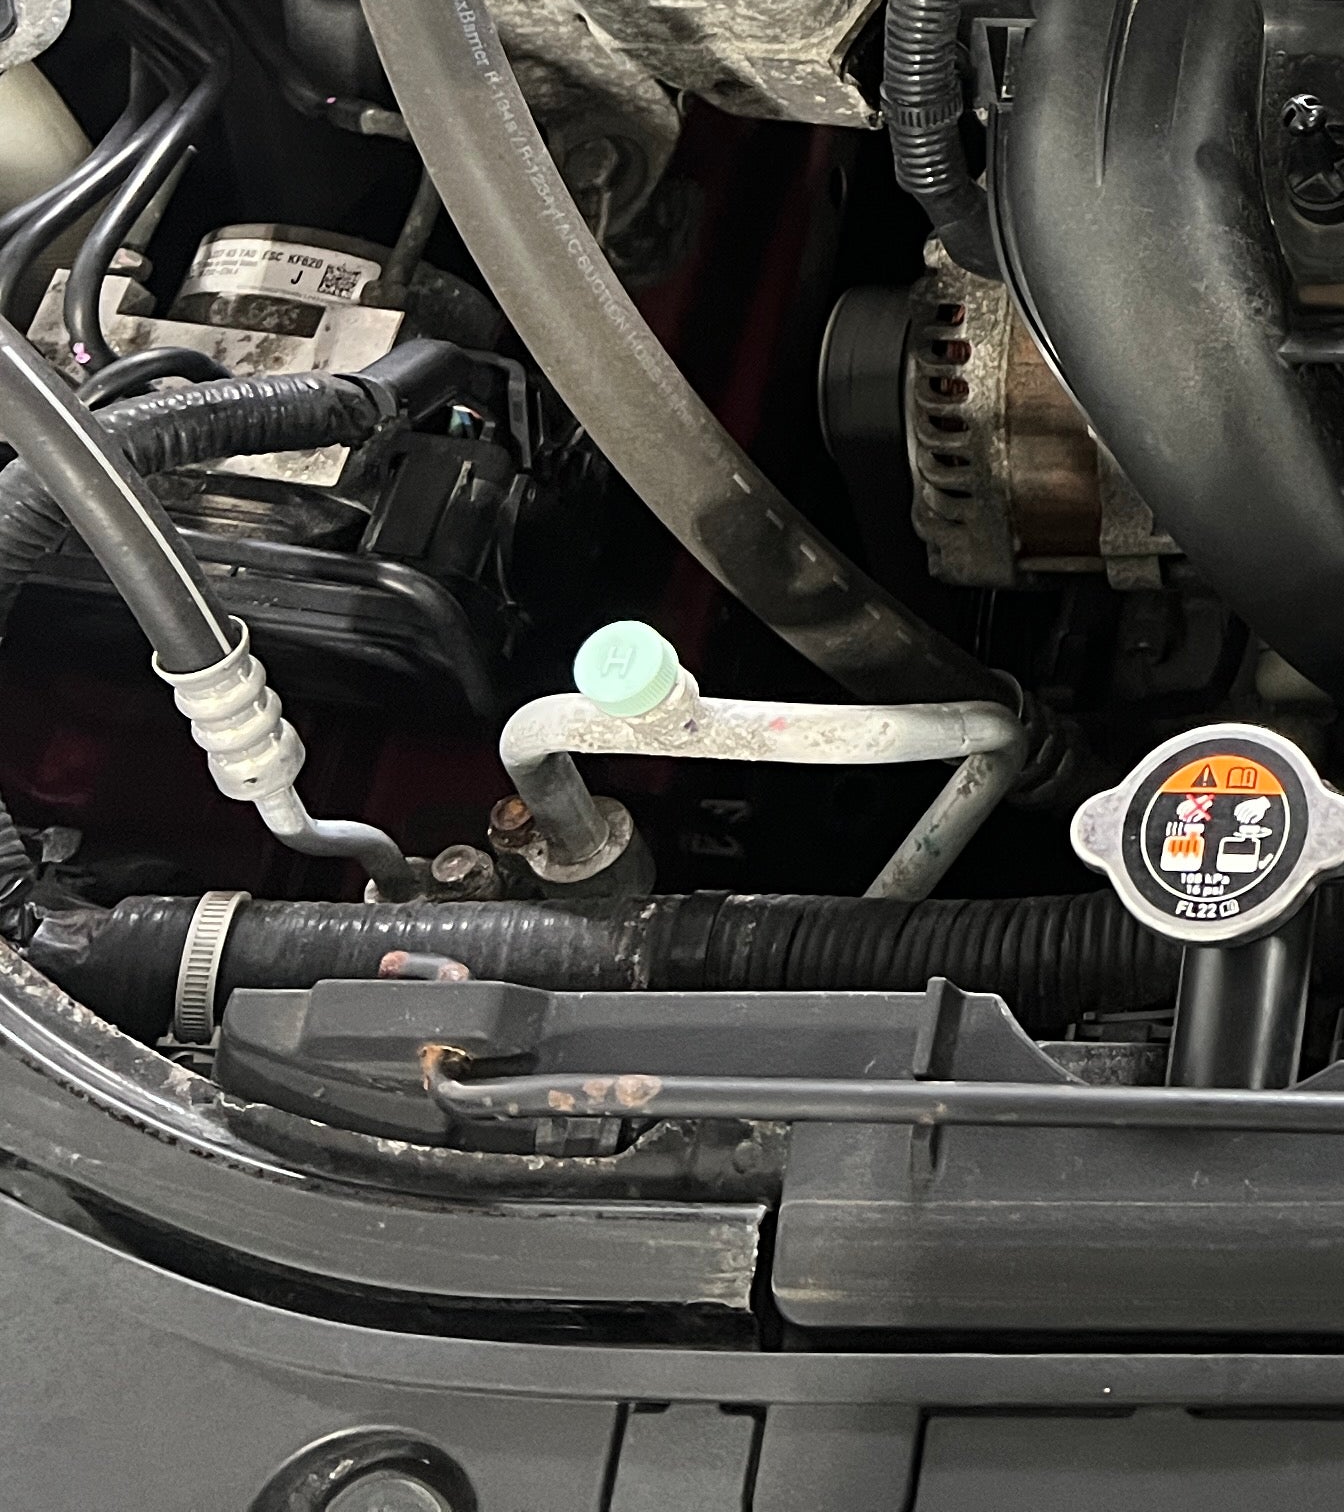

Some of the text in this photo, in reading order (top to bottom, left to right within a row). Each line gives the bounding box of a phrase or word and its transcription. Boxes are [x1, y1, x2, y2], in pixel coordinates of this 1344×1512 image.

[291, 270, 303, 285] J
[600, 645, 636, 679] H
[1175, 899, 1217, 919] FL22
